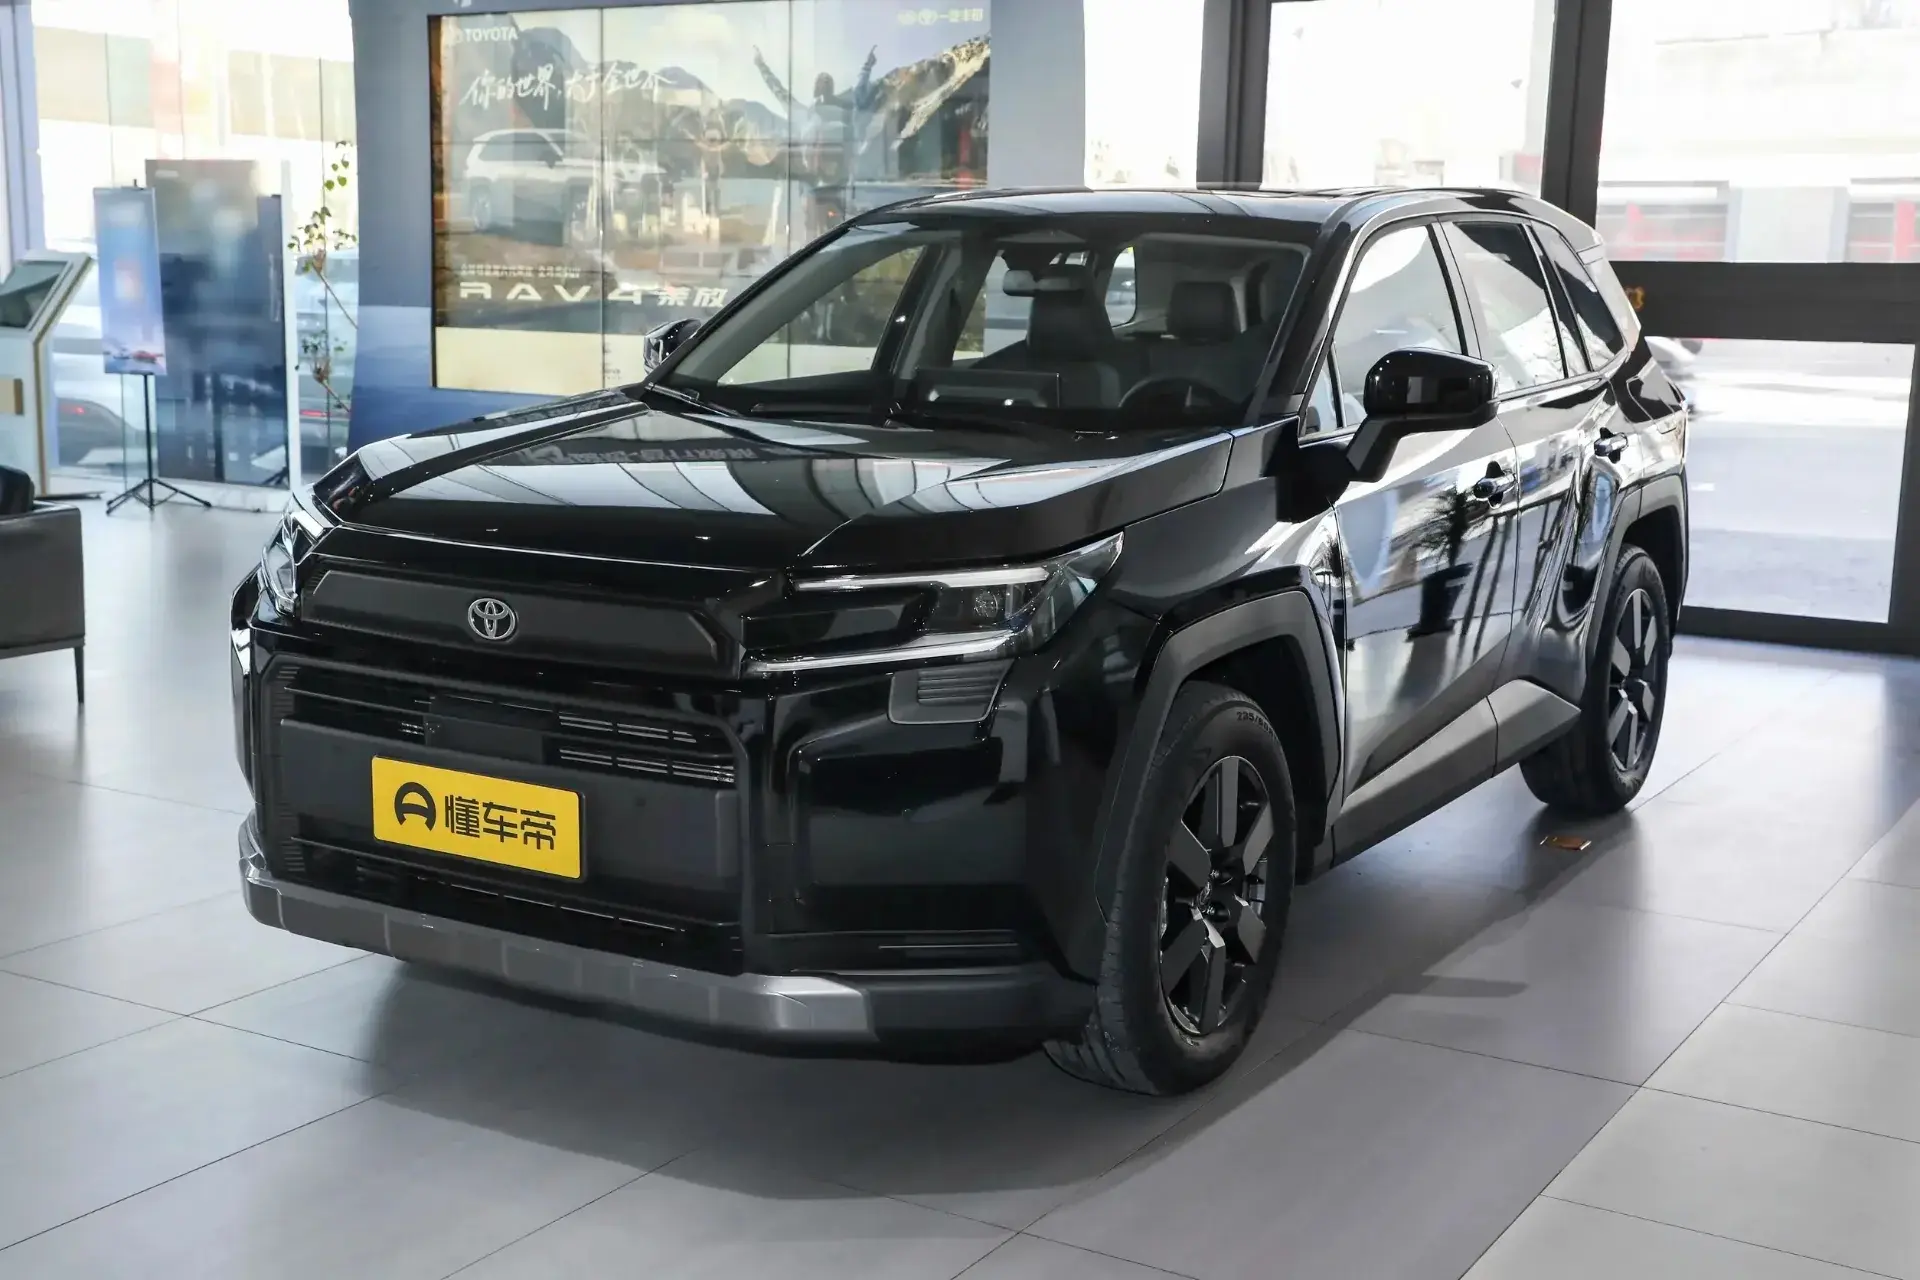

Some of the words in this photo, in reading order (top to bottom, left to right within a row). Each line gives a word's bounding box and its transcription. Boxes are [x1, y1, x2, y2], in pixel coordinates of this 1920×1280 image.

[464, 27, 519, 42] TOYOTA
[445, 794, 556, 850] 懂车帝
